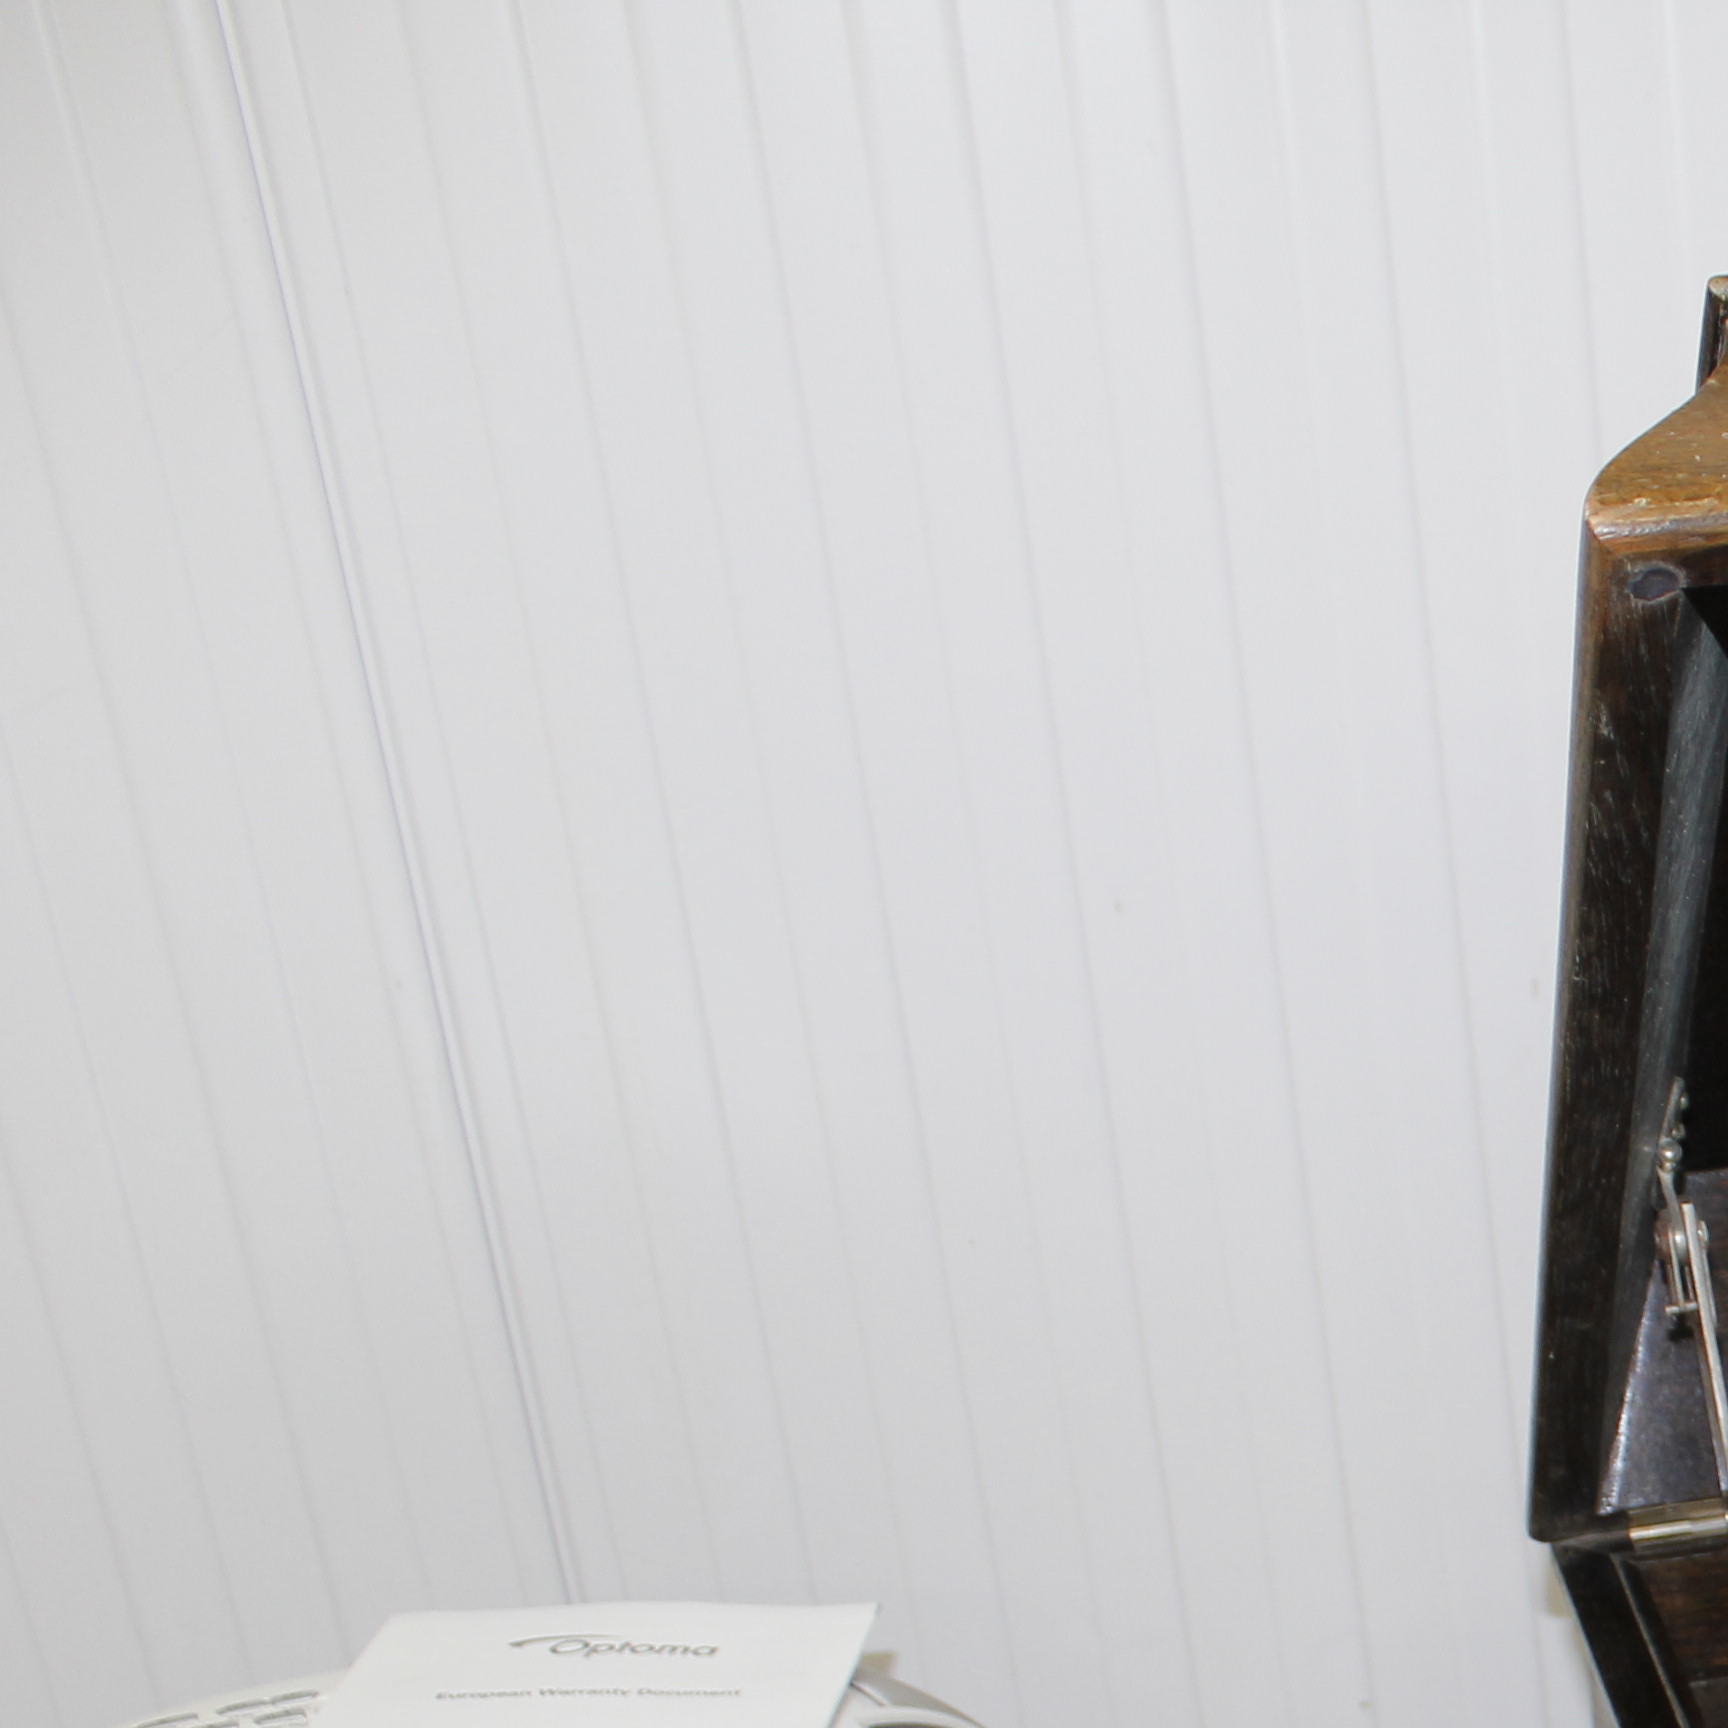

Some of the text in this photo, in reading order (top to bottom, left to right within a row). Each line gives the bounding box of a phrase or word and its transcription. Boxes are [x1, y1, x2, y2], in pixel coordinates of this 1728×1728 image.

[549, 1638, 720, 1660] Optoma
[436, 1687, 741, 1700] European Warranty Document
